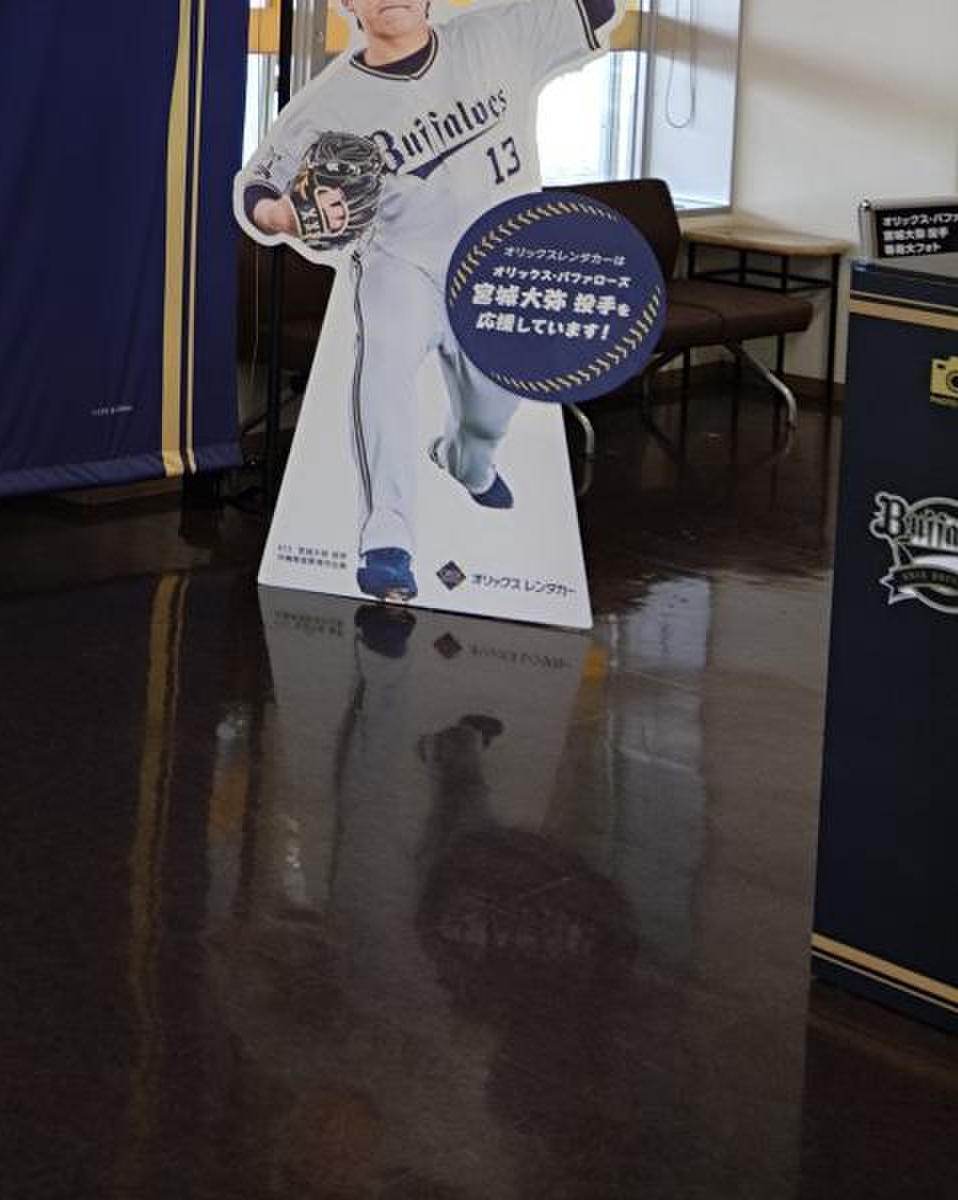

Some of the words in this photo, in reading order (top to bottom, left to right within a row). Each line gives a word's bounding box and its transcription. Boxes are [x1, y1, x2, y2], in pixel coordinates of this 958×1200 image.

[486, 136, 521, 185] 13
[504, 246, 626, 267] オリックスレンタカーは
[472, 282, 568, 312] 宮城大弥
[573, 292, 631, 318] 投手を
